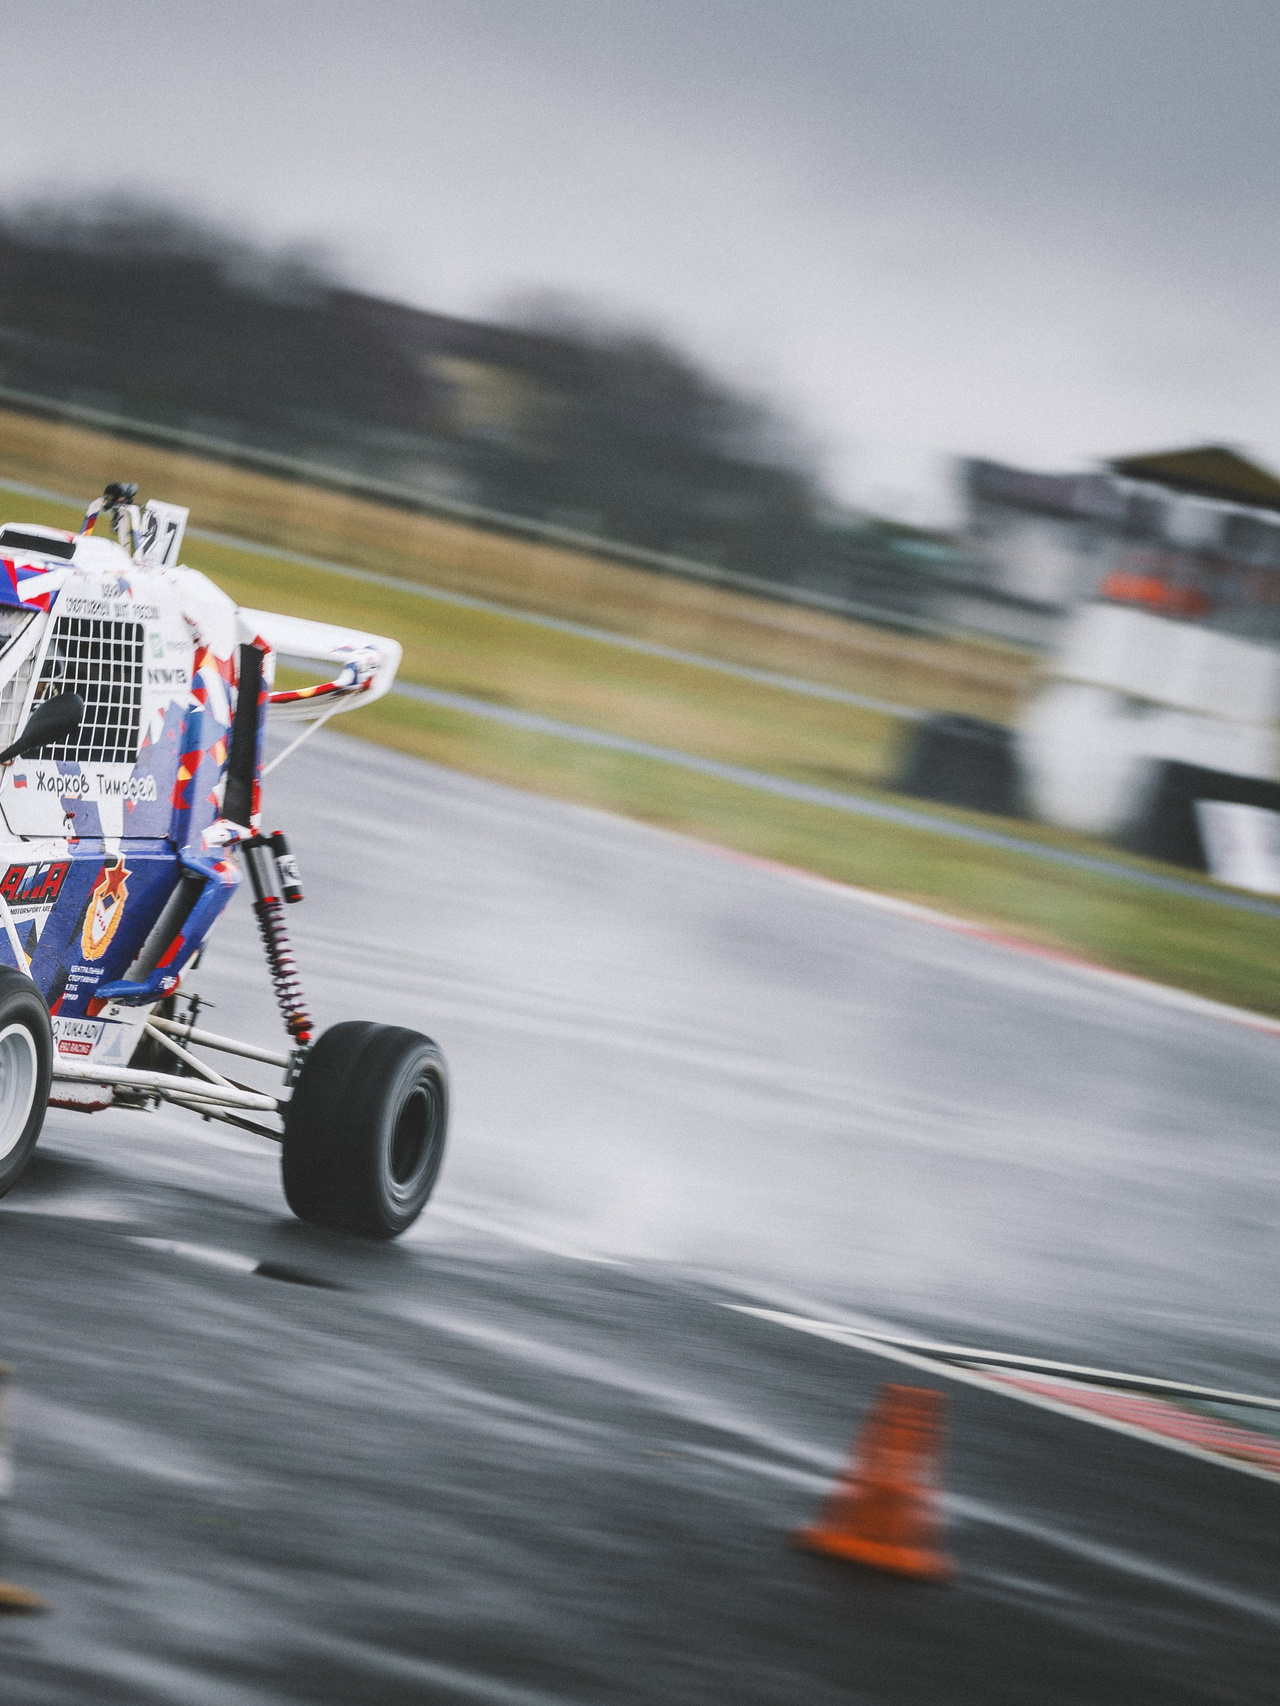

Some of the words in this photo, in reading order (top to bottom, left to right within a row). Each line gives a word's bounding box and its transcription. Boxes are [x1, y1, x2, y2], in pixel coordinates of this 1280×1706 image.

[139, 510, 177, 565] 27
[36, 770, 90, 797] Жарков
[97, 774, 155, 803] Тимофей
[10, 907, 42, 916] MOTORSPORT
[71, 965, 105, 974] ЦЕНТРАЛЬНЫЙ
[68, 974, 100, 983] СПОРТИВНЫЙ
